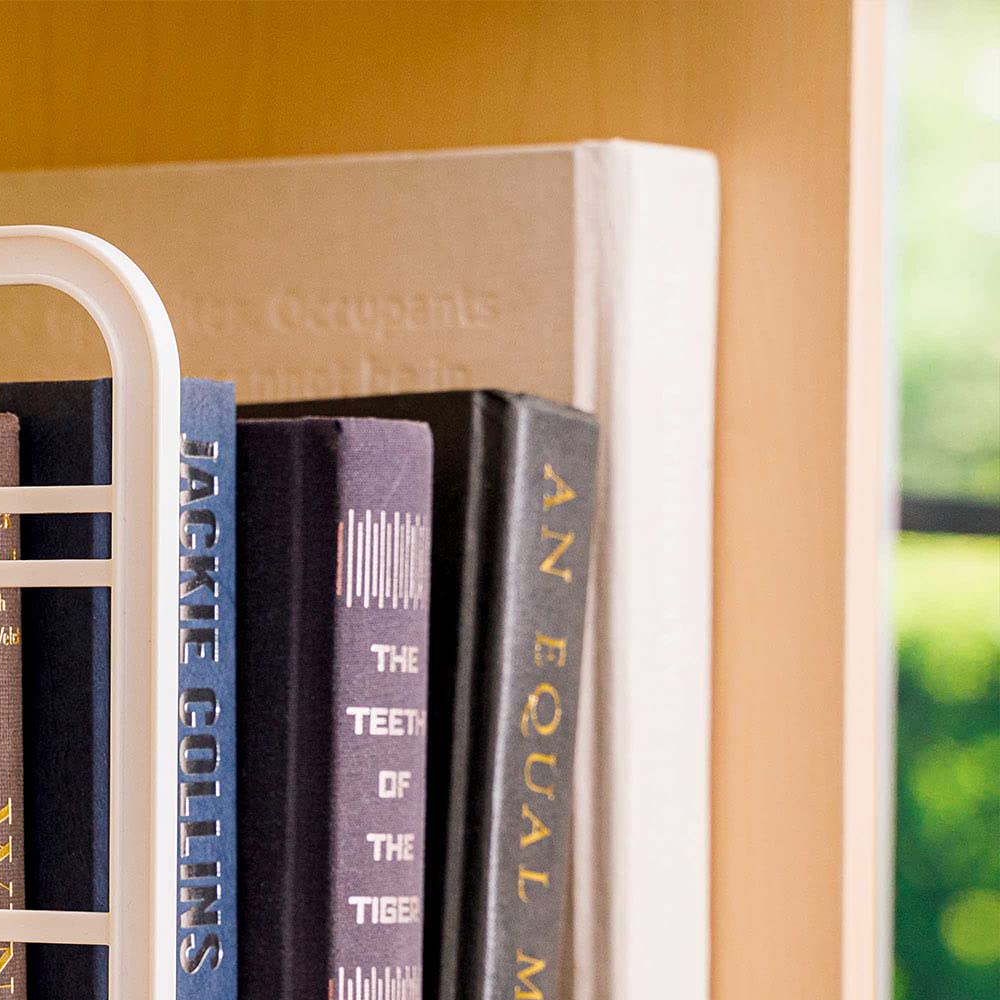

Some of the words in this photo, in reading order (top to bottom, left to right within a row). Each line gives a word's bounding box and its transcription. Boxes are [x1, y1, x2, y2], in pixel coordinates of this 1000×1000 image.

[538, 463, 577, 584] AN
[179, 432, 221, 663] JACKIE
[370, 643, 420, 673] THE
[346, 706, 428, 736] TEETH
[517, 630, 568, 904] EQUAL
[378, 770, 412, 799] OF
[178, 687, 223, 975] COLLINS
[366, 833, 415, 862] THE
[348, 895, 421, 924] TIGER
